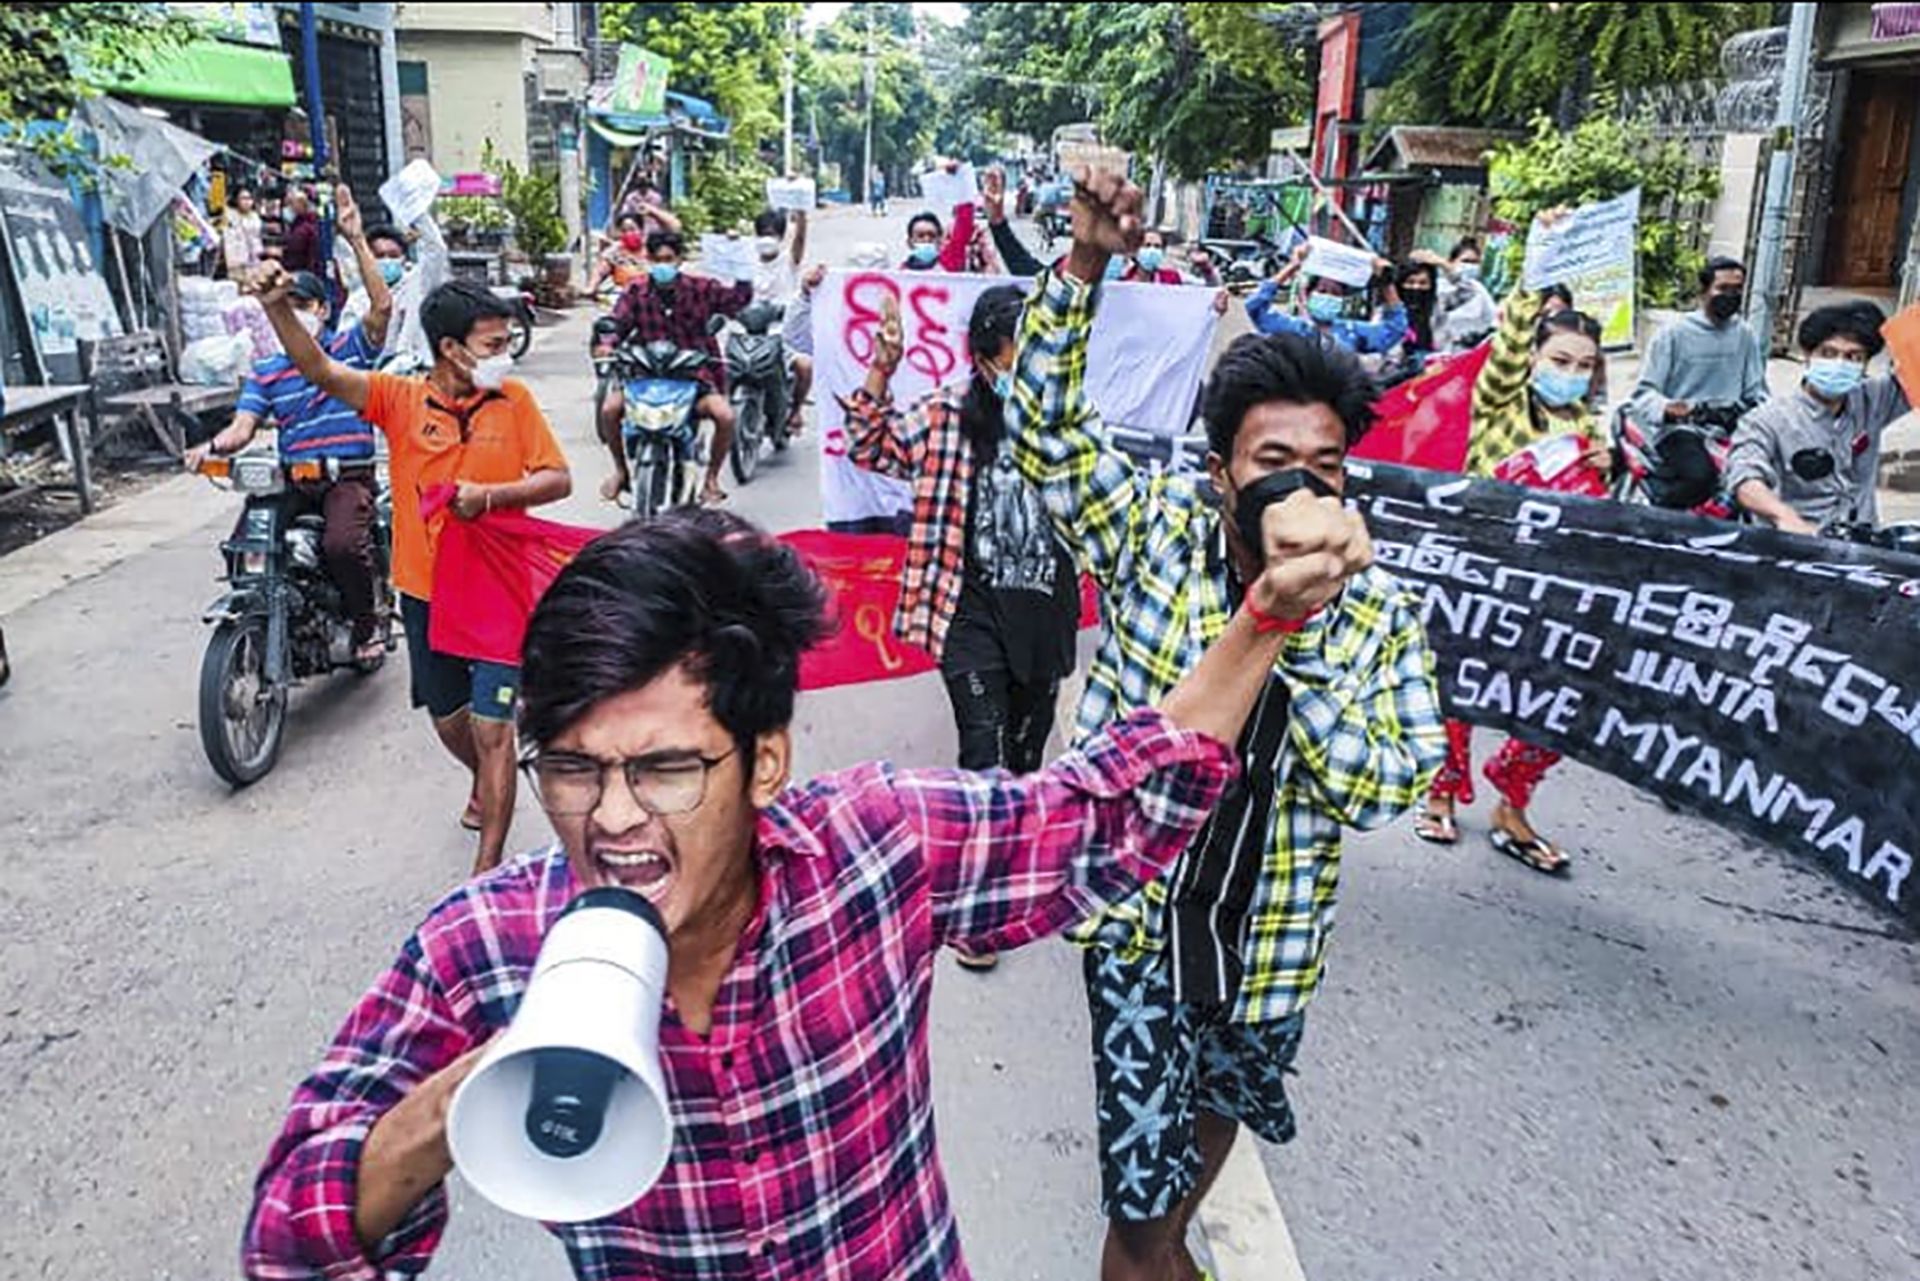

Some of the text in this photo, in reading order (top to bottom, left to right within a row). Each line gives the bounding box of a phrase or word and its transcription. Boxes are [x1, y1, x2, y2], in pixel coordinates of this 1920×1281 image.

[1541, 619, 1602, 669] TO
[1614, 649, 1778, 733] JUNTA
[1452, 658, 1913, 901] SAVE MYANMAR
